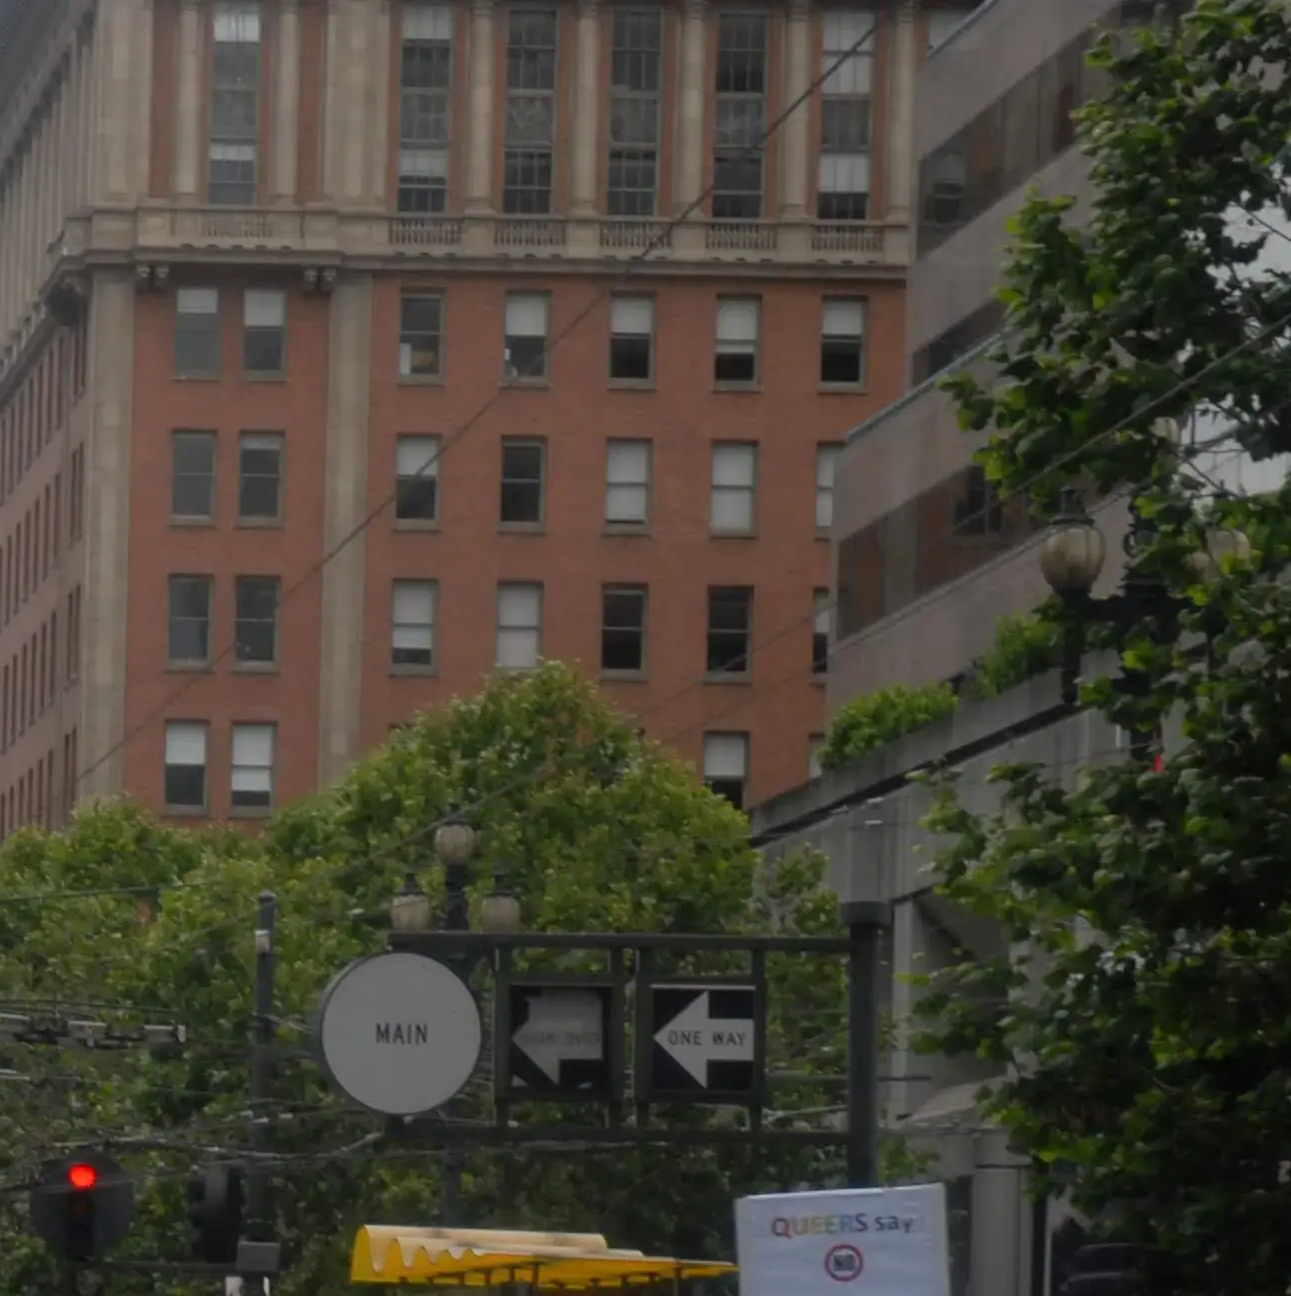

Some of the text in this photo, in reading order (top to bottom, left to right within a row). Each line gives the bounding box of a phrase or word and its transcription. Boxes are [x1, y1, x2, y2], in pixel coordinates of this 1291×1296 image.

[375, 1022, 428, 1045] MAIN
[668, 1030, 747, 1046] ONE WAY
[771, 1213, 914, 1239] QUEERS say
